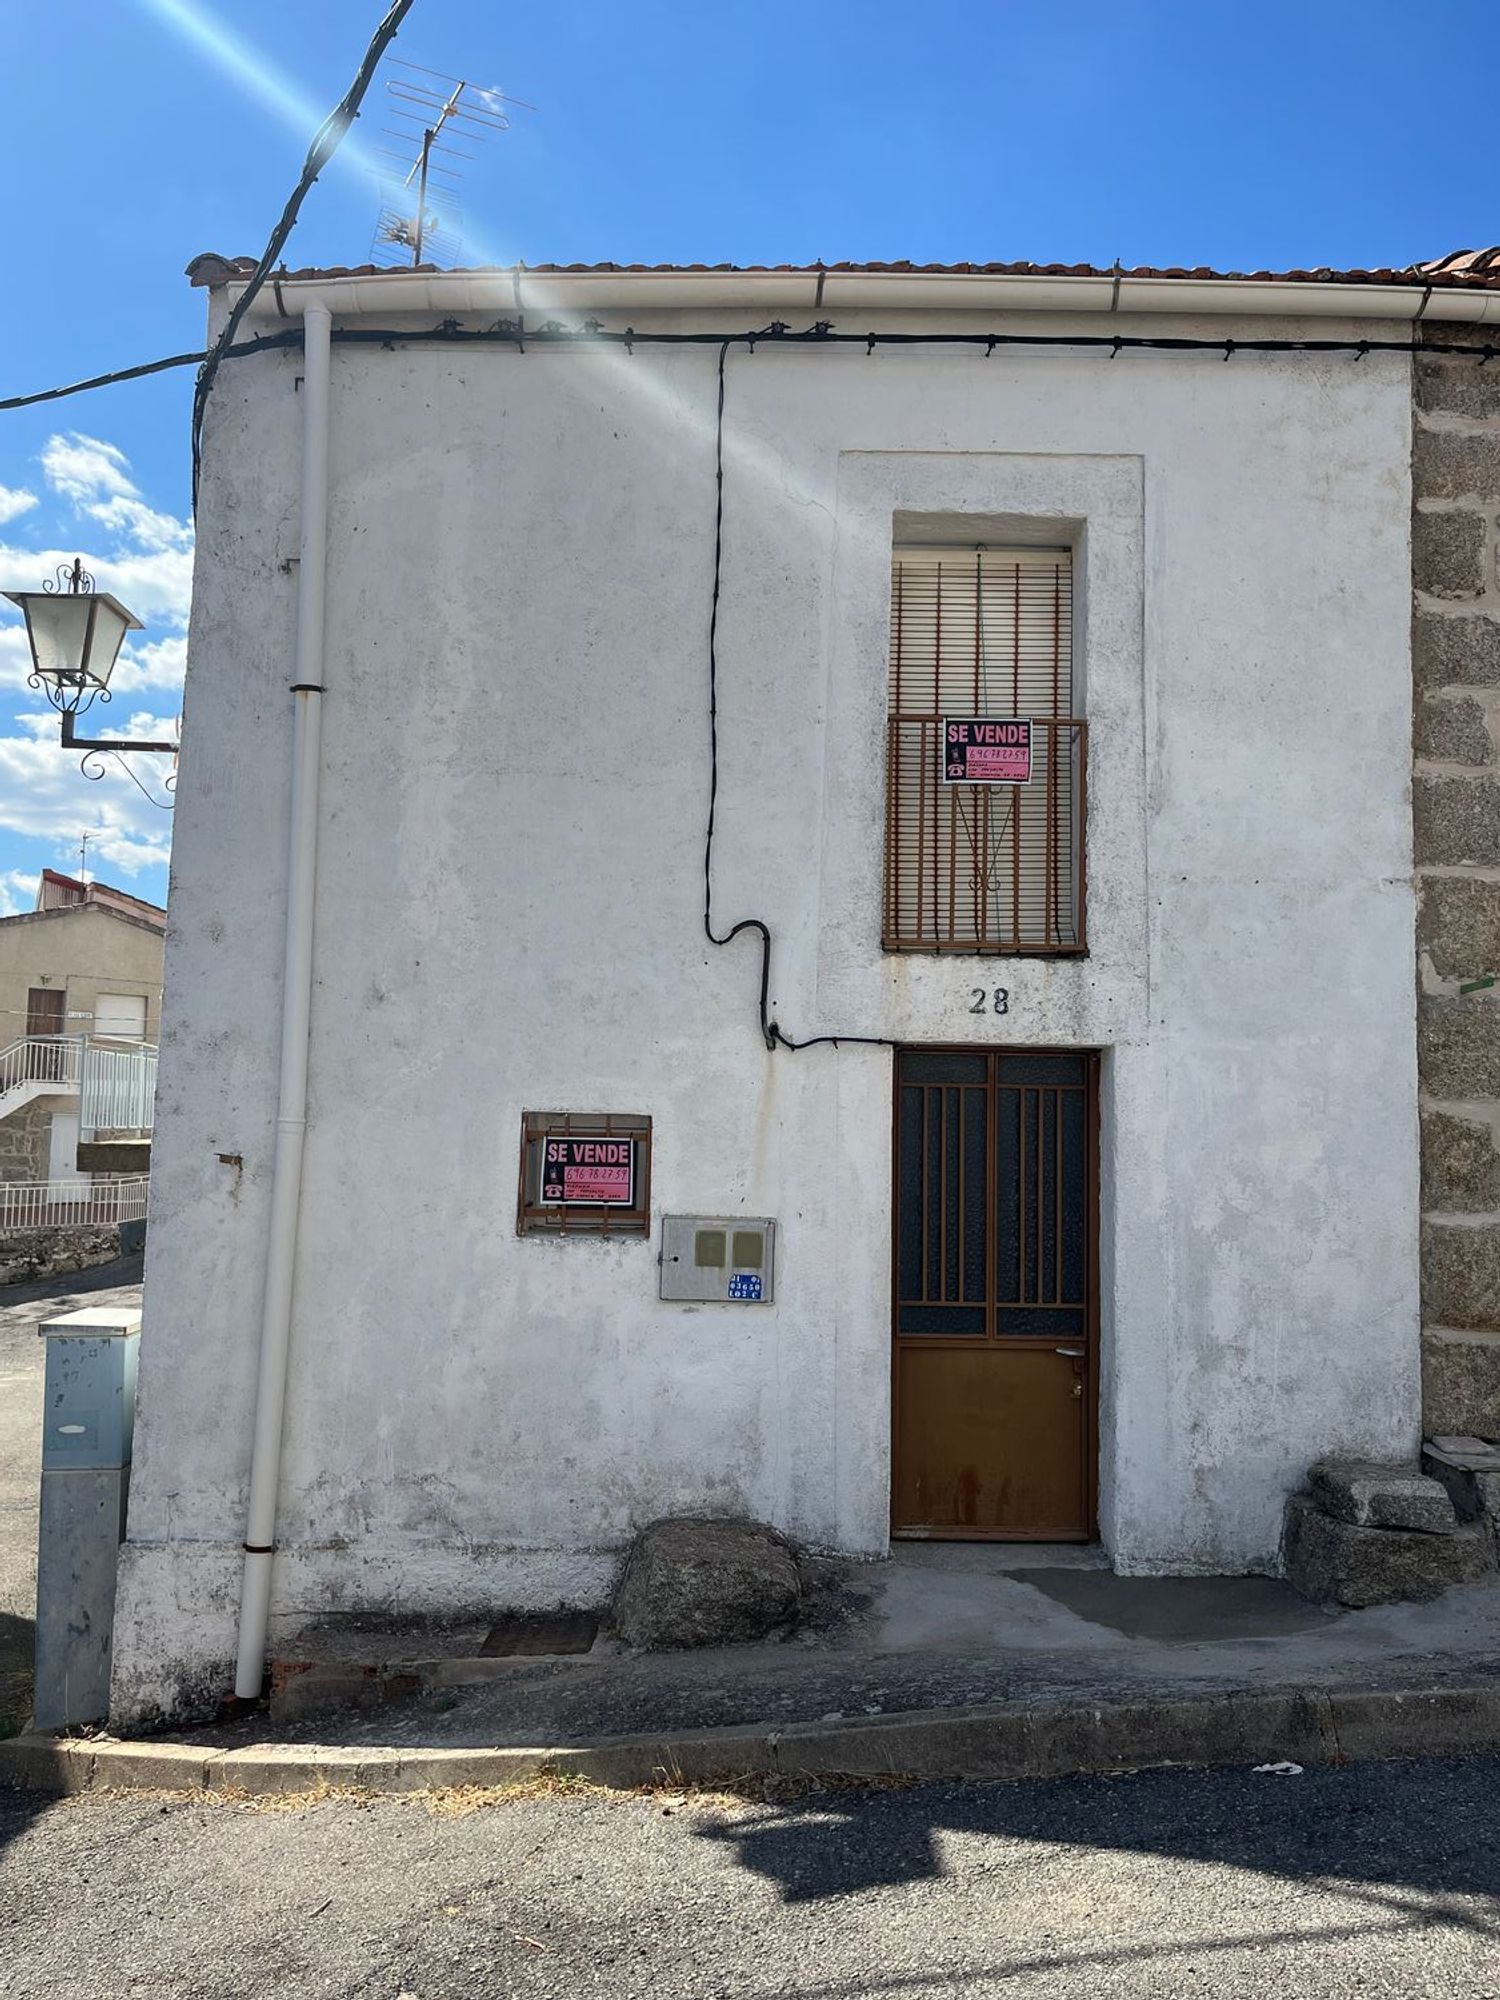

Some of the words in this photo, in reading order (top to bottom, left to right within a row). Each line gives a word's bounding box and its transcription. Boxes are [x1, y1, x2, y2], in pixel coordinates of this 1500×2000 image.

[948, 725, 968, 742] SE
[974, 725, 1028, 743] VENDE
[969, 988, 1009, 1015] 28
[548, 1143, 567, 1162] SE
[573, 1144, 628, 1163] VENDE
